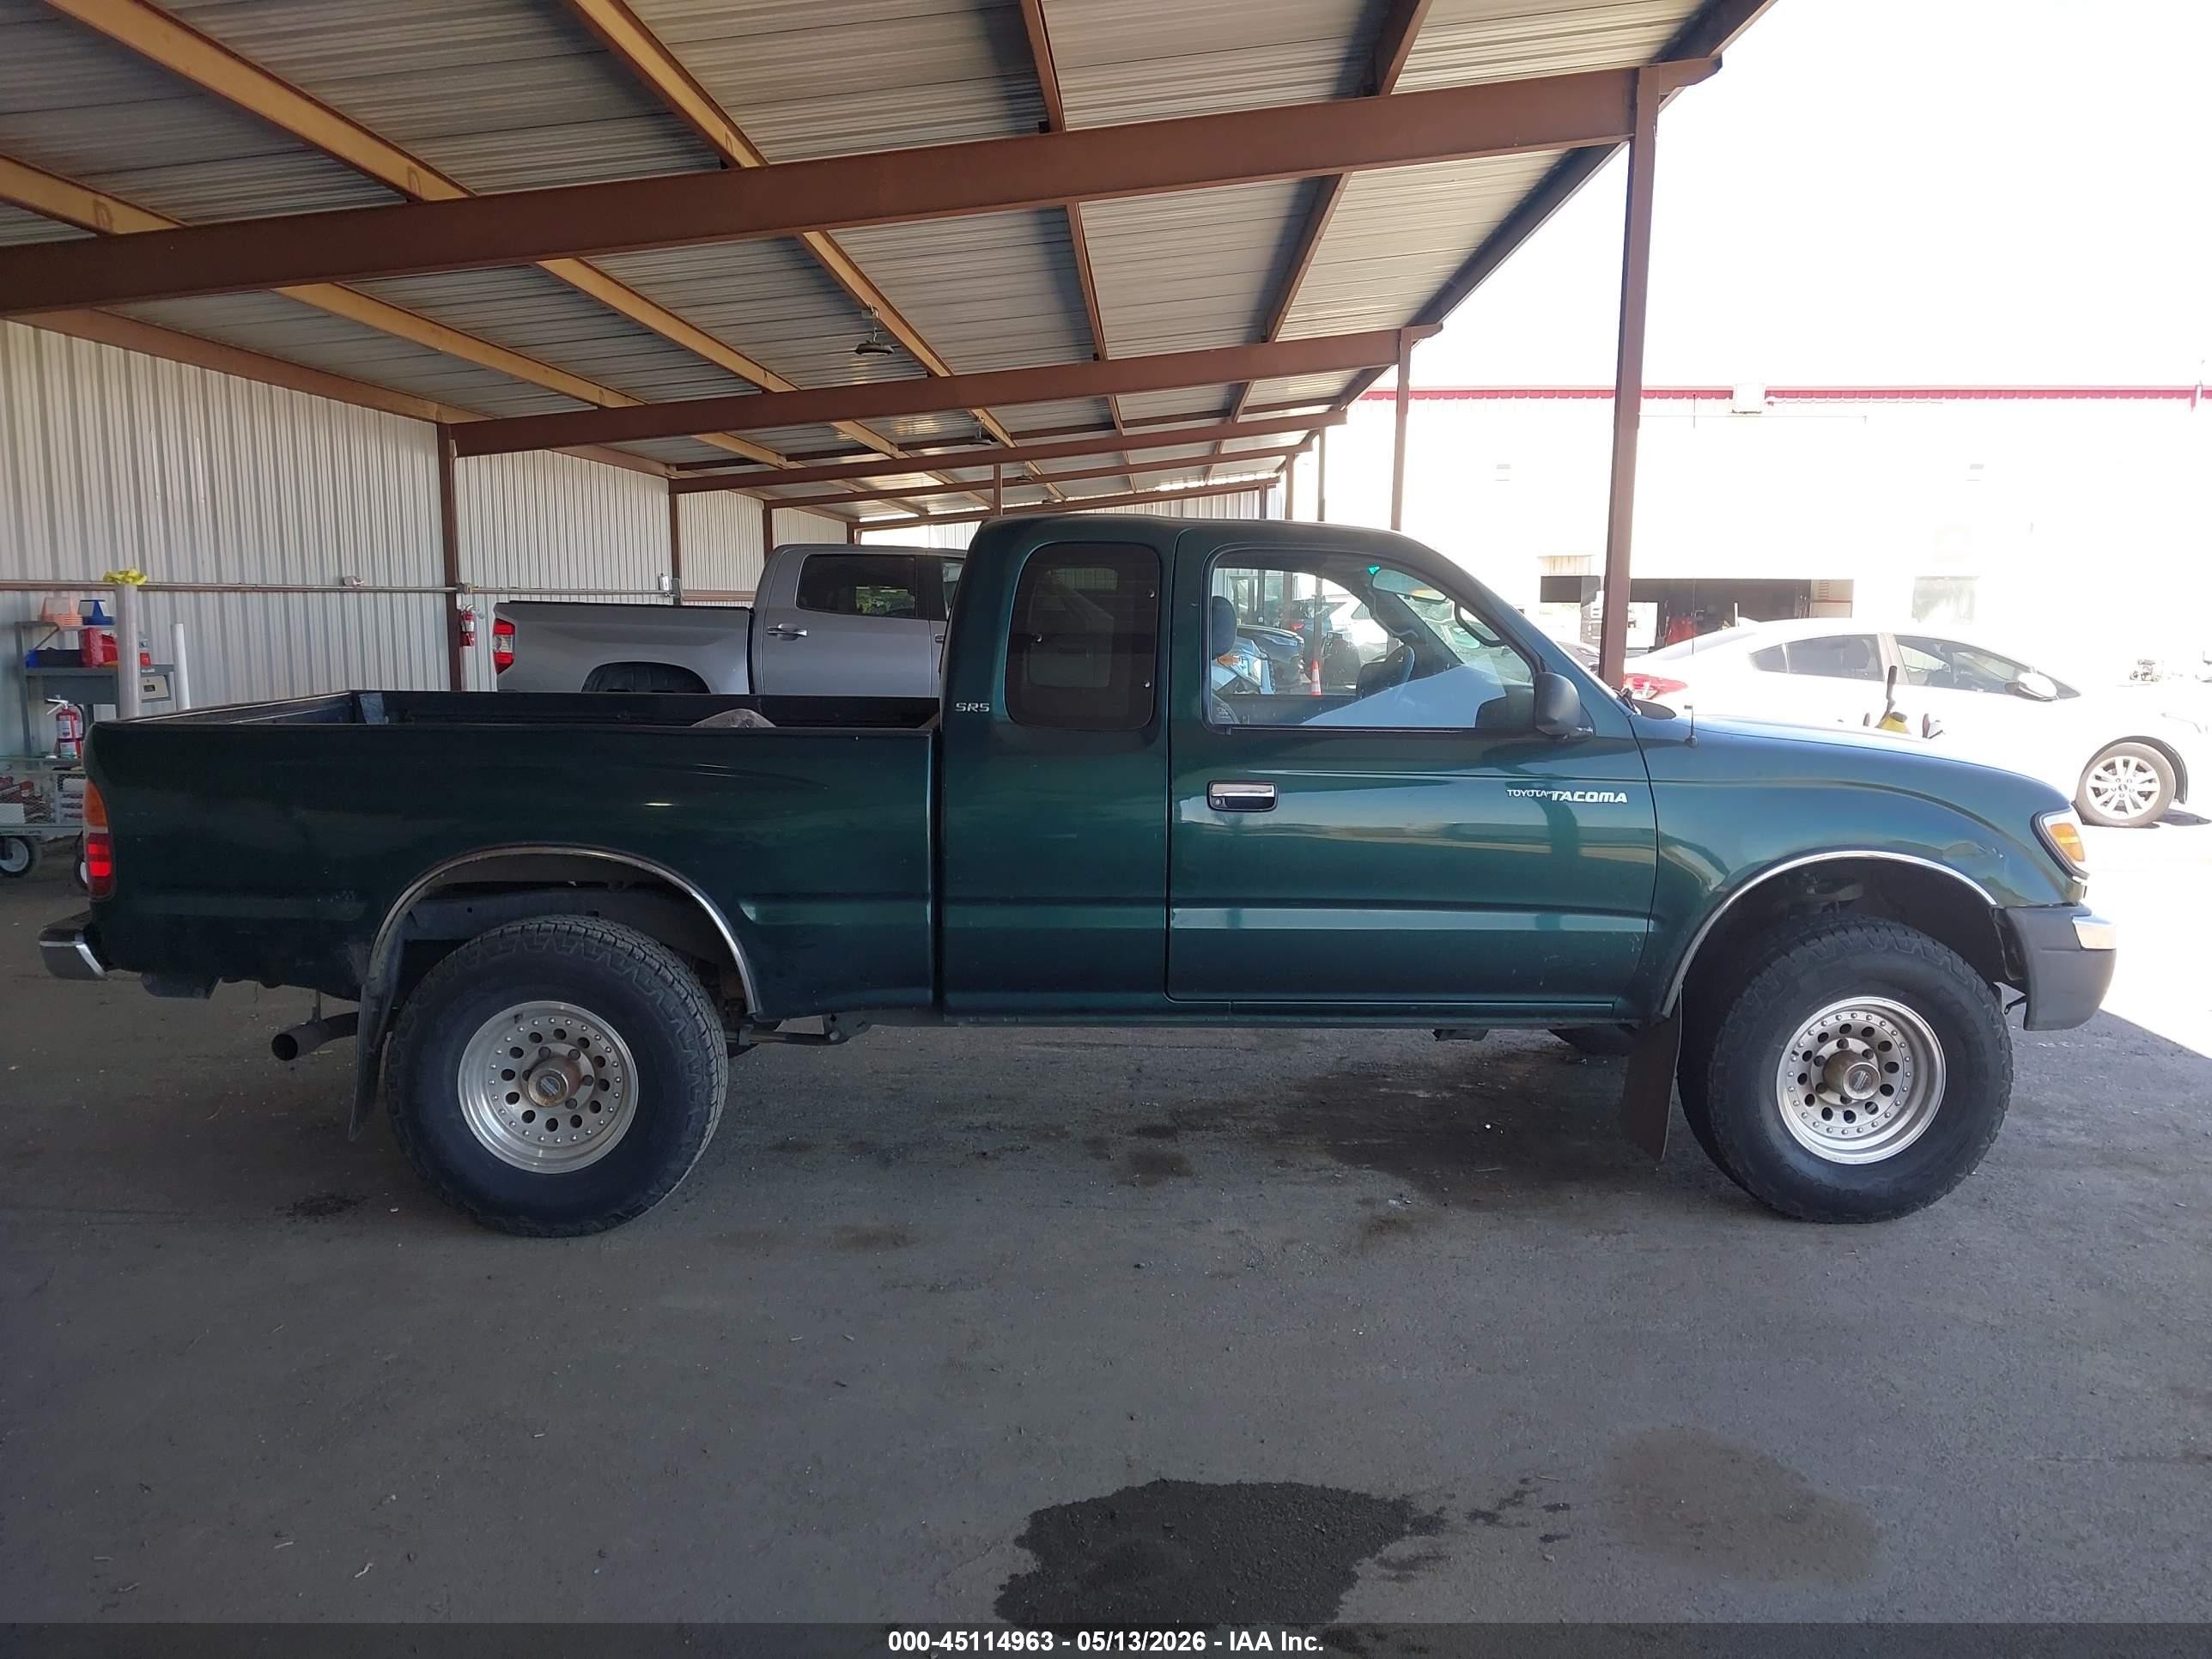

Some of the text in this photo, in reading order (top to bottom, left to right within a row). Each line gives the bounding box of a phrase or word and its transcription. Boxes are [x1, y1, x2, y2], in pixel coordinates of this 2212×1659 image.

[954, 702, 990, 713] SR5
[1506, 788, 1629, 805] TOYOTA TACOMA
